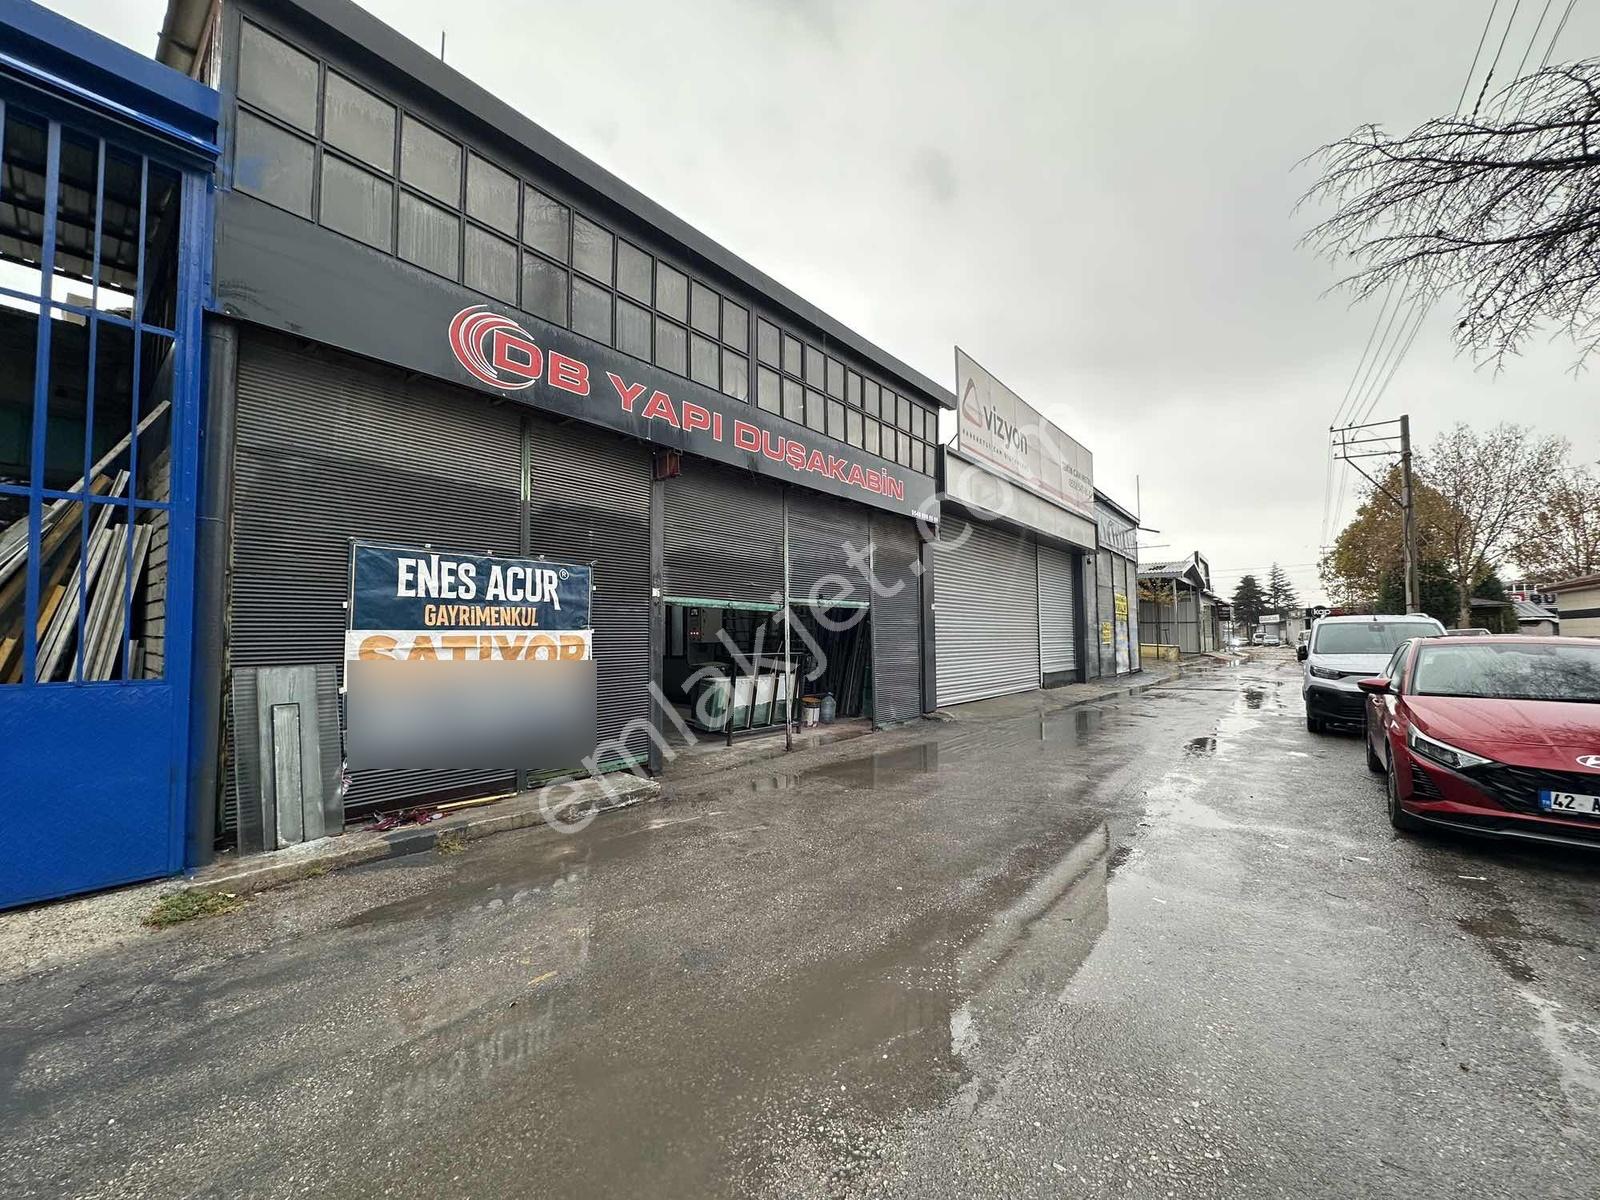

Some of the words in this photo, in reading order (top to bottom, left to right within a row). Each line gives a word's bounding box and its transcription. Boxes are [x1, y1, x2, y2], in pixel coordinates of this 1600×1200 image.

[493, 329, 590, 396] DB
[606, 371, 722, 441] YAPI
[734, 419, 904, 501] DUŞAKABİN
[983, 405, 1028, 455] vizyon
[397, 554, 477, 600] ENES
[1553, 793, 1576, 809] 42
